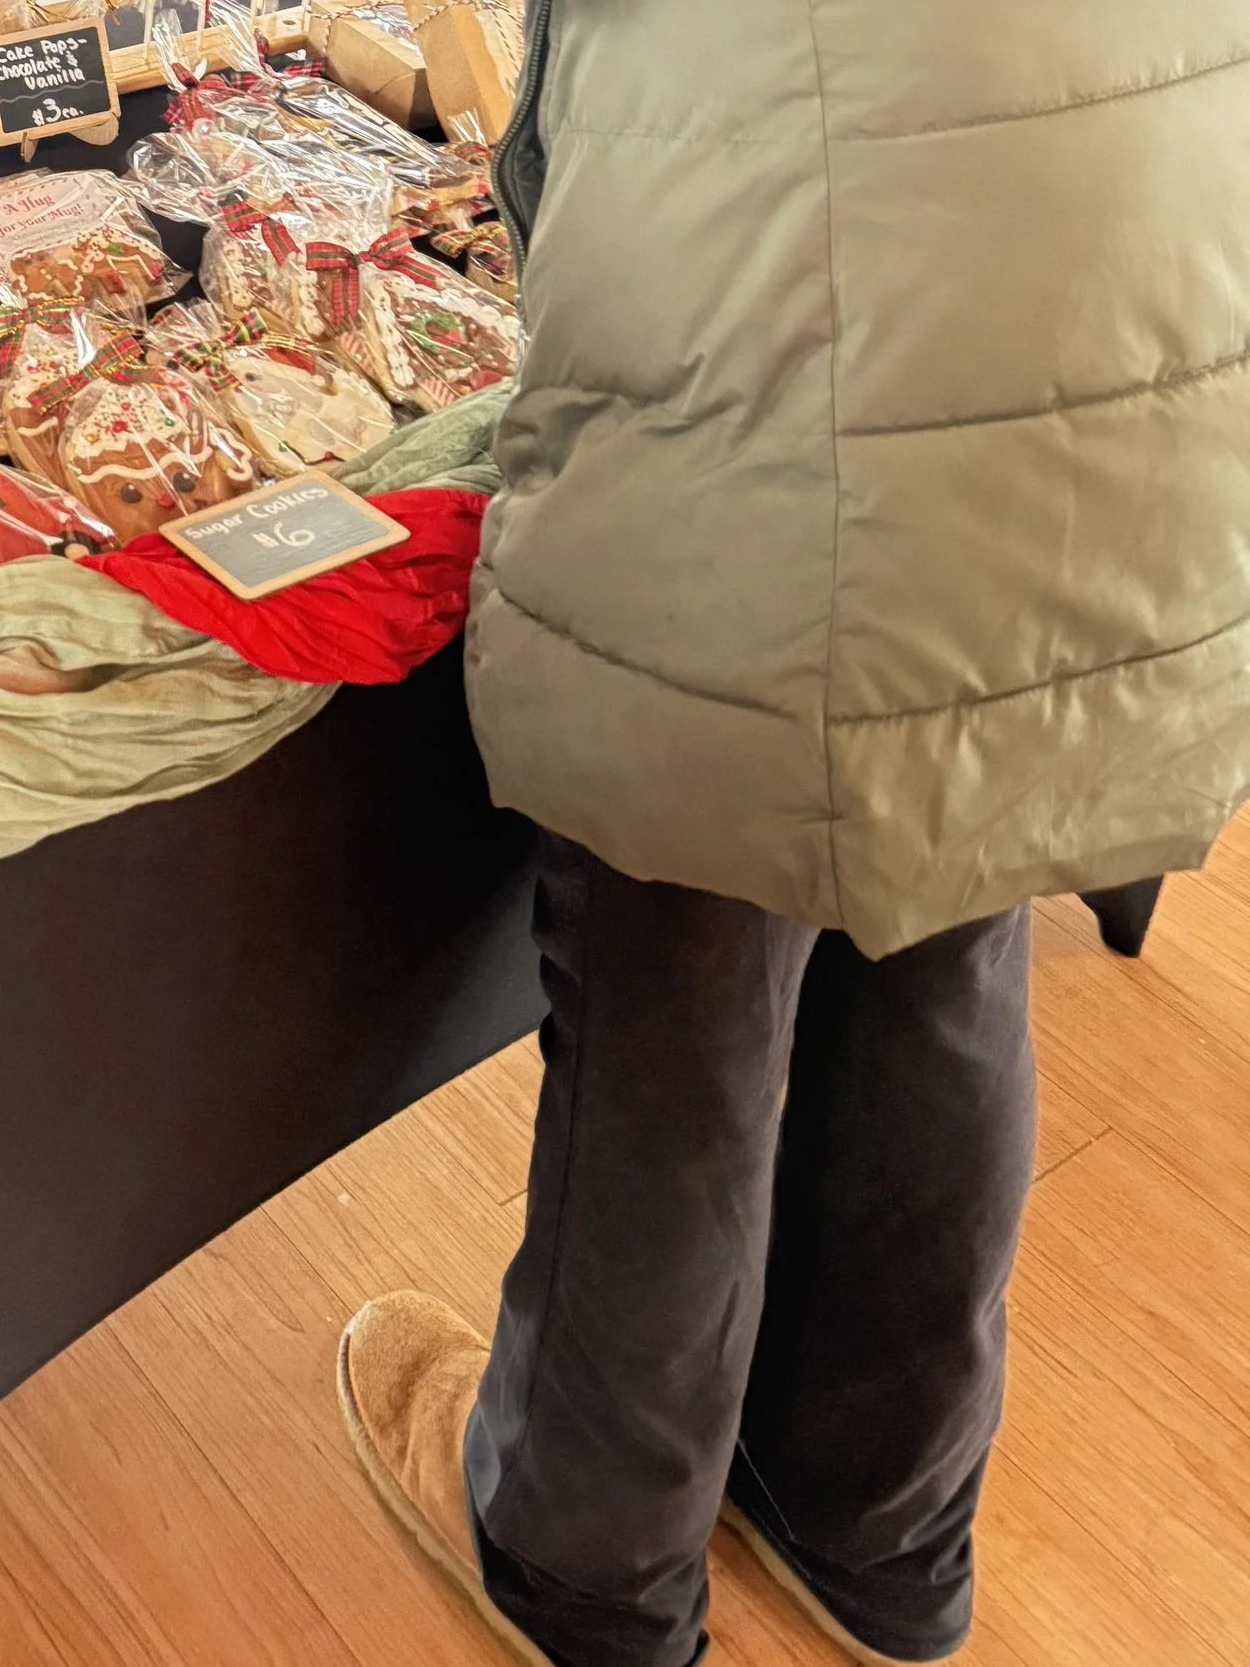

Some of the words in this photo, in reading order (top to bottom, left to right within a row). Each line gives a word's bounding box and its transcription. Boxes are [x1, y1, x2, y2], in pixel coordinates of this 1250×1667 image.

[18, 195, 56, 211] Hug
[17, 214, 47, 229] your
[47, 204, 85, 222] Mug!
[185, 513, 244, 541] Sugar
[246, 487, 329, 519] Cookies
[252, 521, 316, 548] $6
